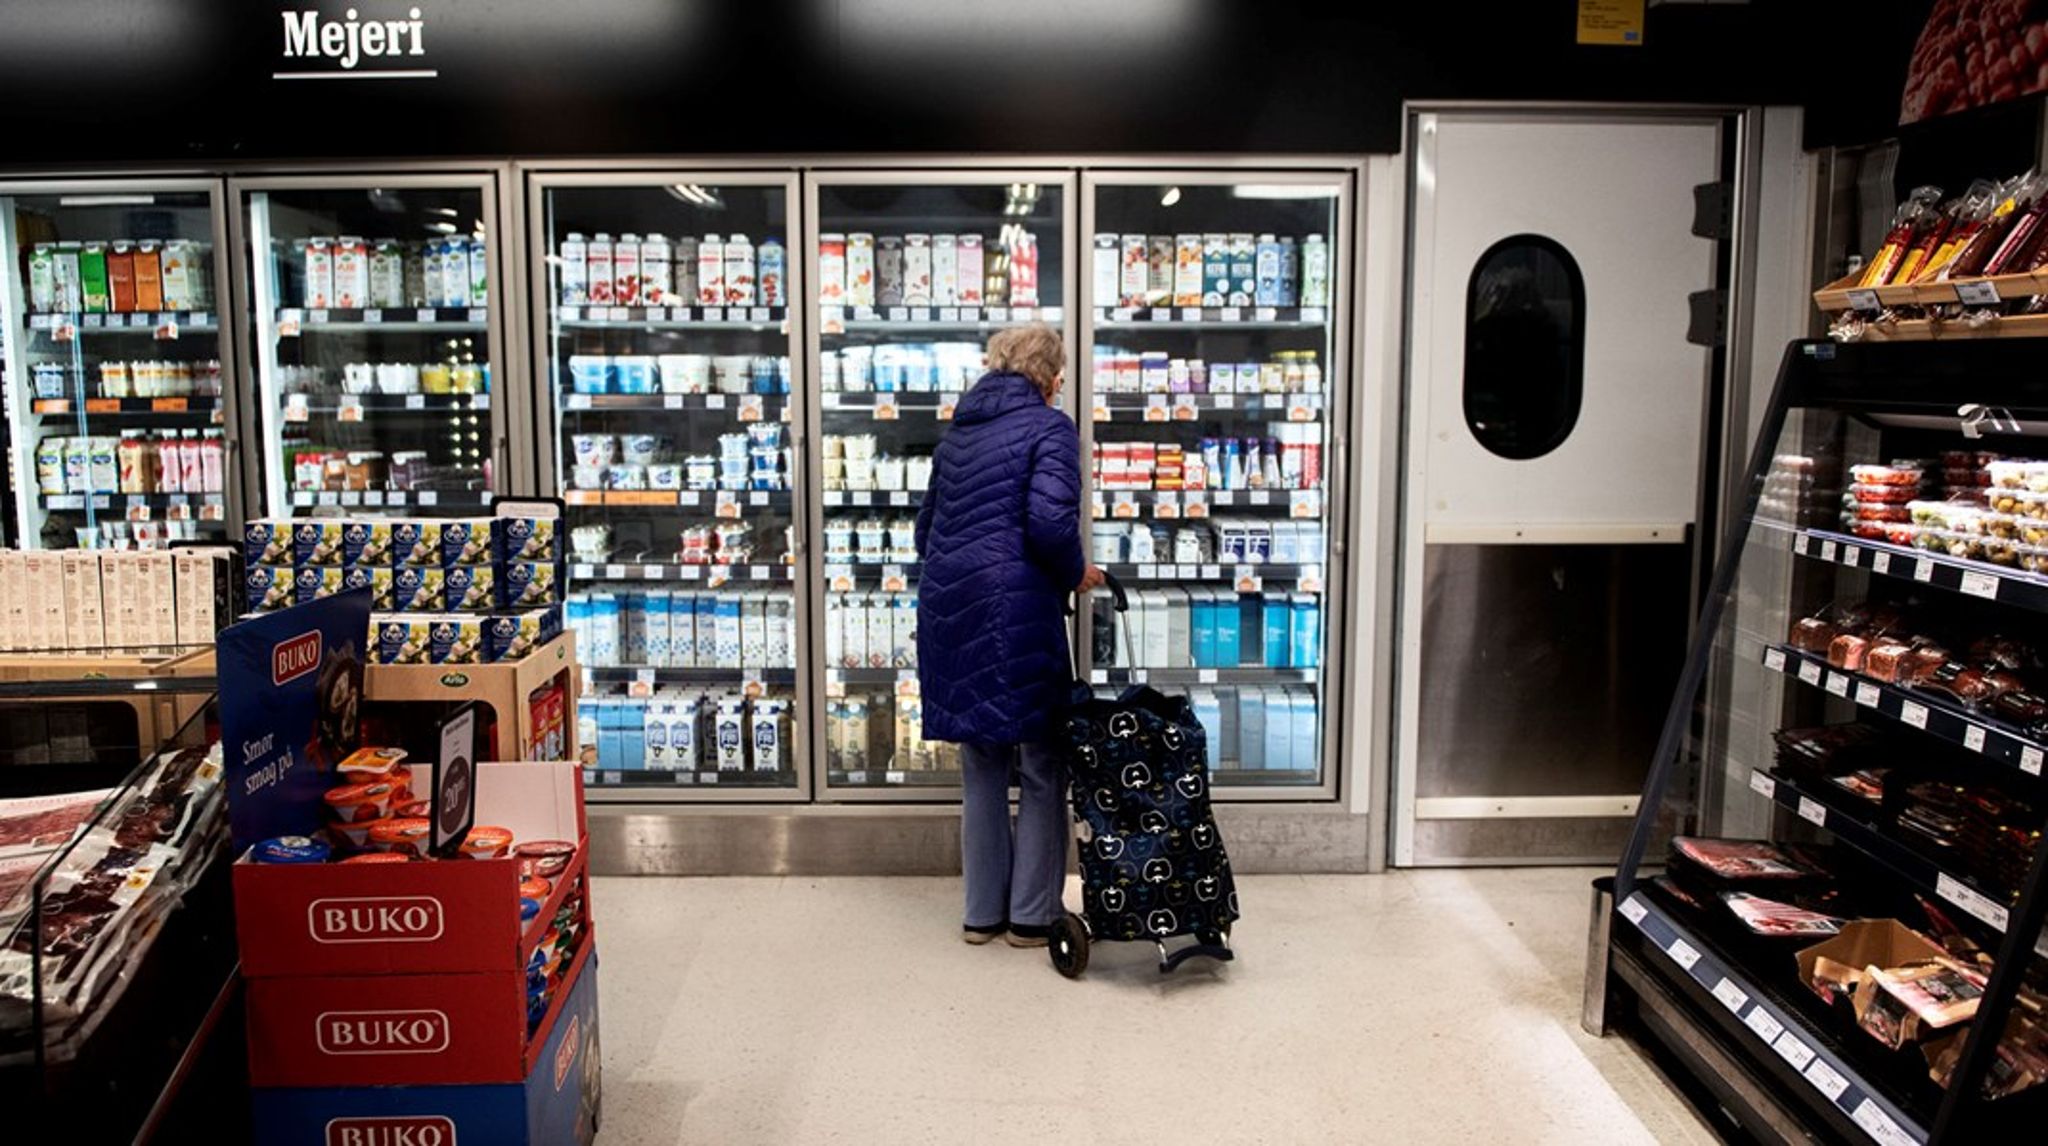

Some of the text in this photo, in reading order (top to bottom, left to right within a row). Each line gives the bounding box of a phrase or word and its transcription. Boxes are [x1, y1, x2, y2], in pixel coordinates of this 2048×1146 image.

[281, 7, 425, 69] Mejeri
[278, 640, 317, 675] BUKO
[245, 745, 294, 796] smag på
[324, 906, 428, 932] BUKO
[332, 1019, 434, 1045] BUKO
[341, 1125, 442, 1146] BUKO
